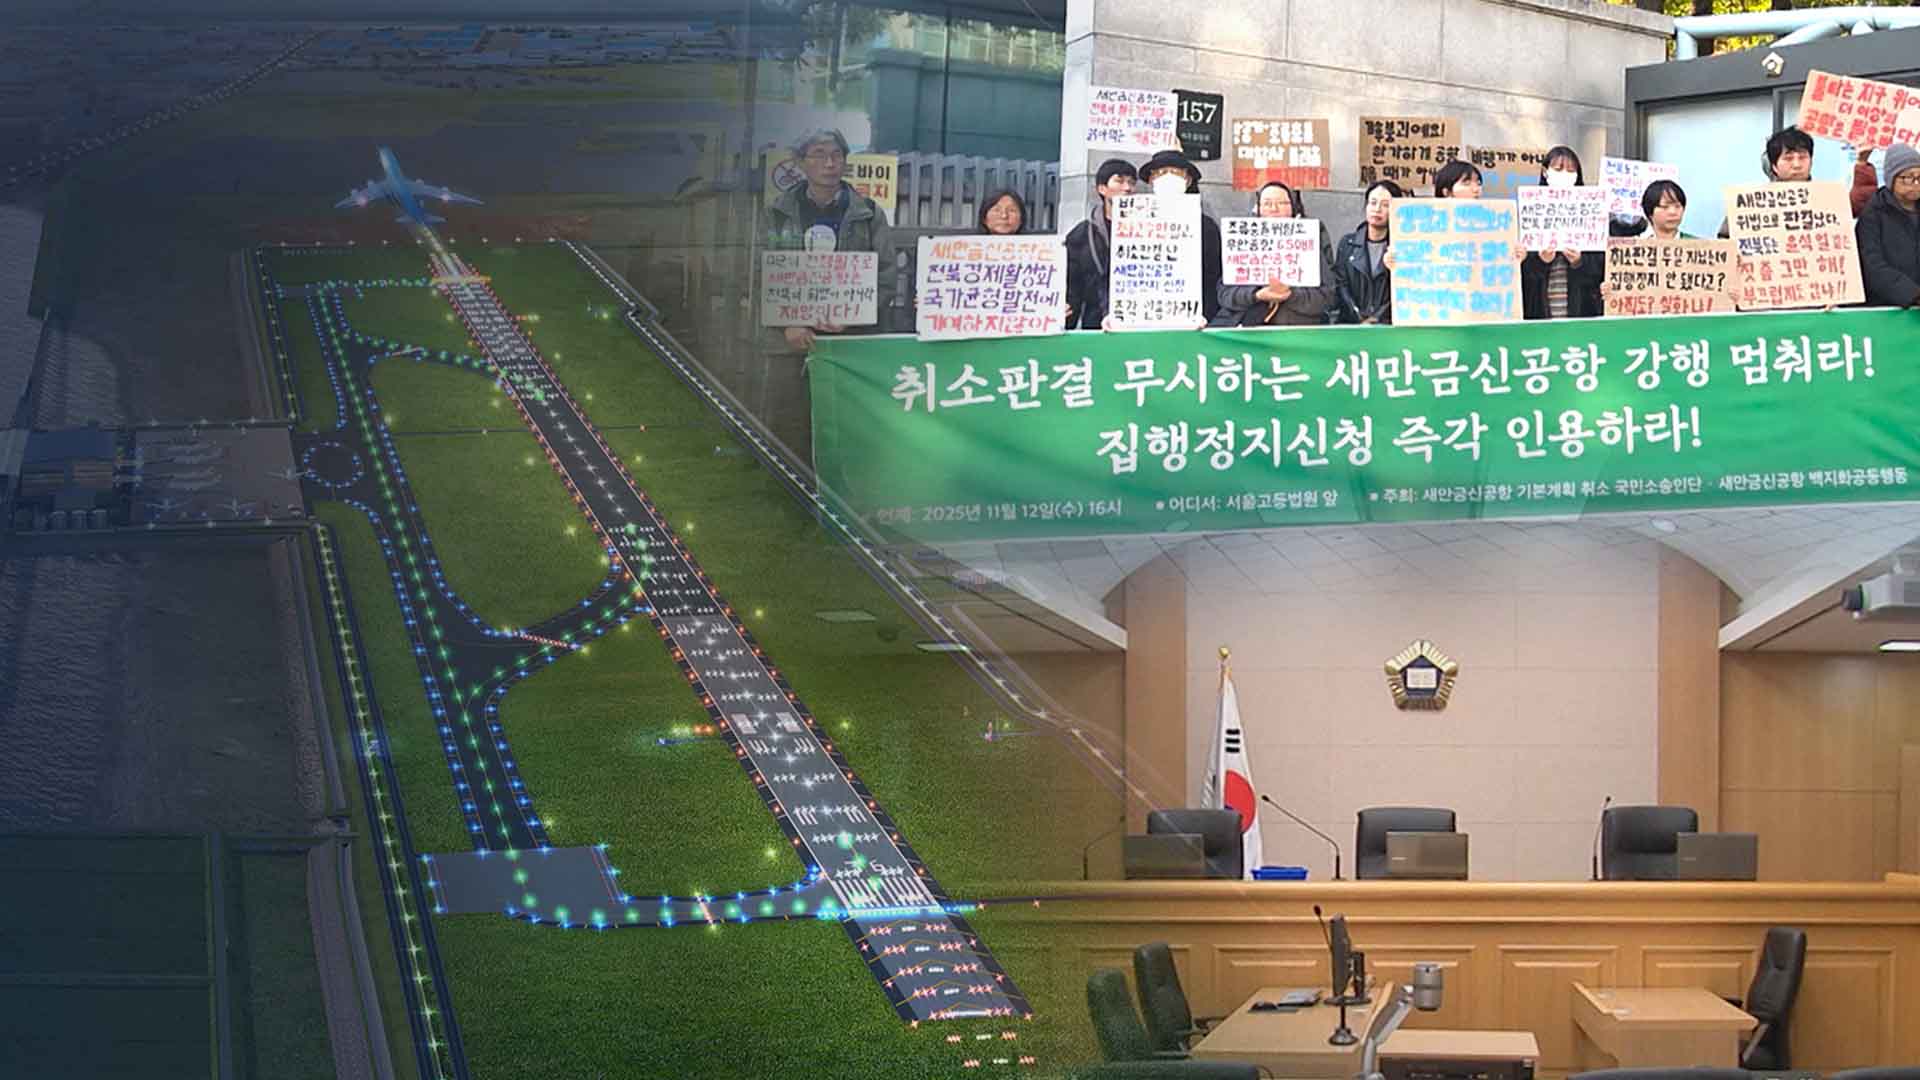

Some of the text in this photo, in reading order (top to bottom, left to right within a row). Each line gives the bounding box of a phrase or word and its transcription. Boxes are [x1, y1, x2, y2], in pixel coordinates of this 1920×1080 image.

[1858, 82, 1887, 104] 지구
[1179, 100, 1218, 123] 157
[1736, 213, 1779, 231] 위법으로
[1611, 246, 1657, 267] 취소판결
[1780, 257, 1809, 278] 그만
[928, 262, 1056, 289] 전북경제활성화
[1611, 272, 1659, 291] 집행정지
[924, 287, 1059, 314] 국가균형발전에
[892, 335, 1875, 412] 취소판결 무시하는 새만금신공항 강행 멈춰라!
[1096, 405, 1702, 475] 집행정지신청 즉각 인용하라!
[1383, 467, 1907, 503] 주최: 새만금신공항 기본계획 취소 국민소송인단 새만금신공항 백지화공동행동
[922, 503, 981, 521] 2025년
[986, 503, 1016, 521] 11월
[1021, 502, 1084, 520] 12일(수)
[1088, 500, 1121, 516] 16시
[1169, 490, 1338, 512] 어디서: 서울고등법원 앞
